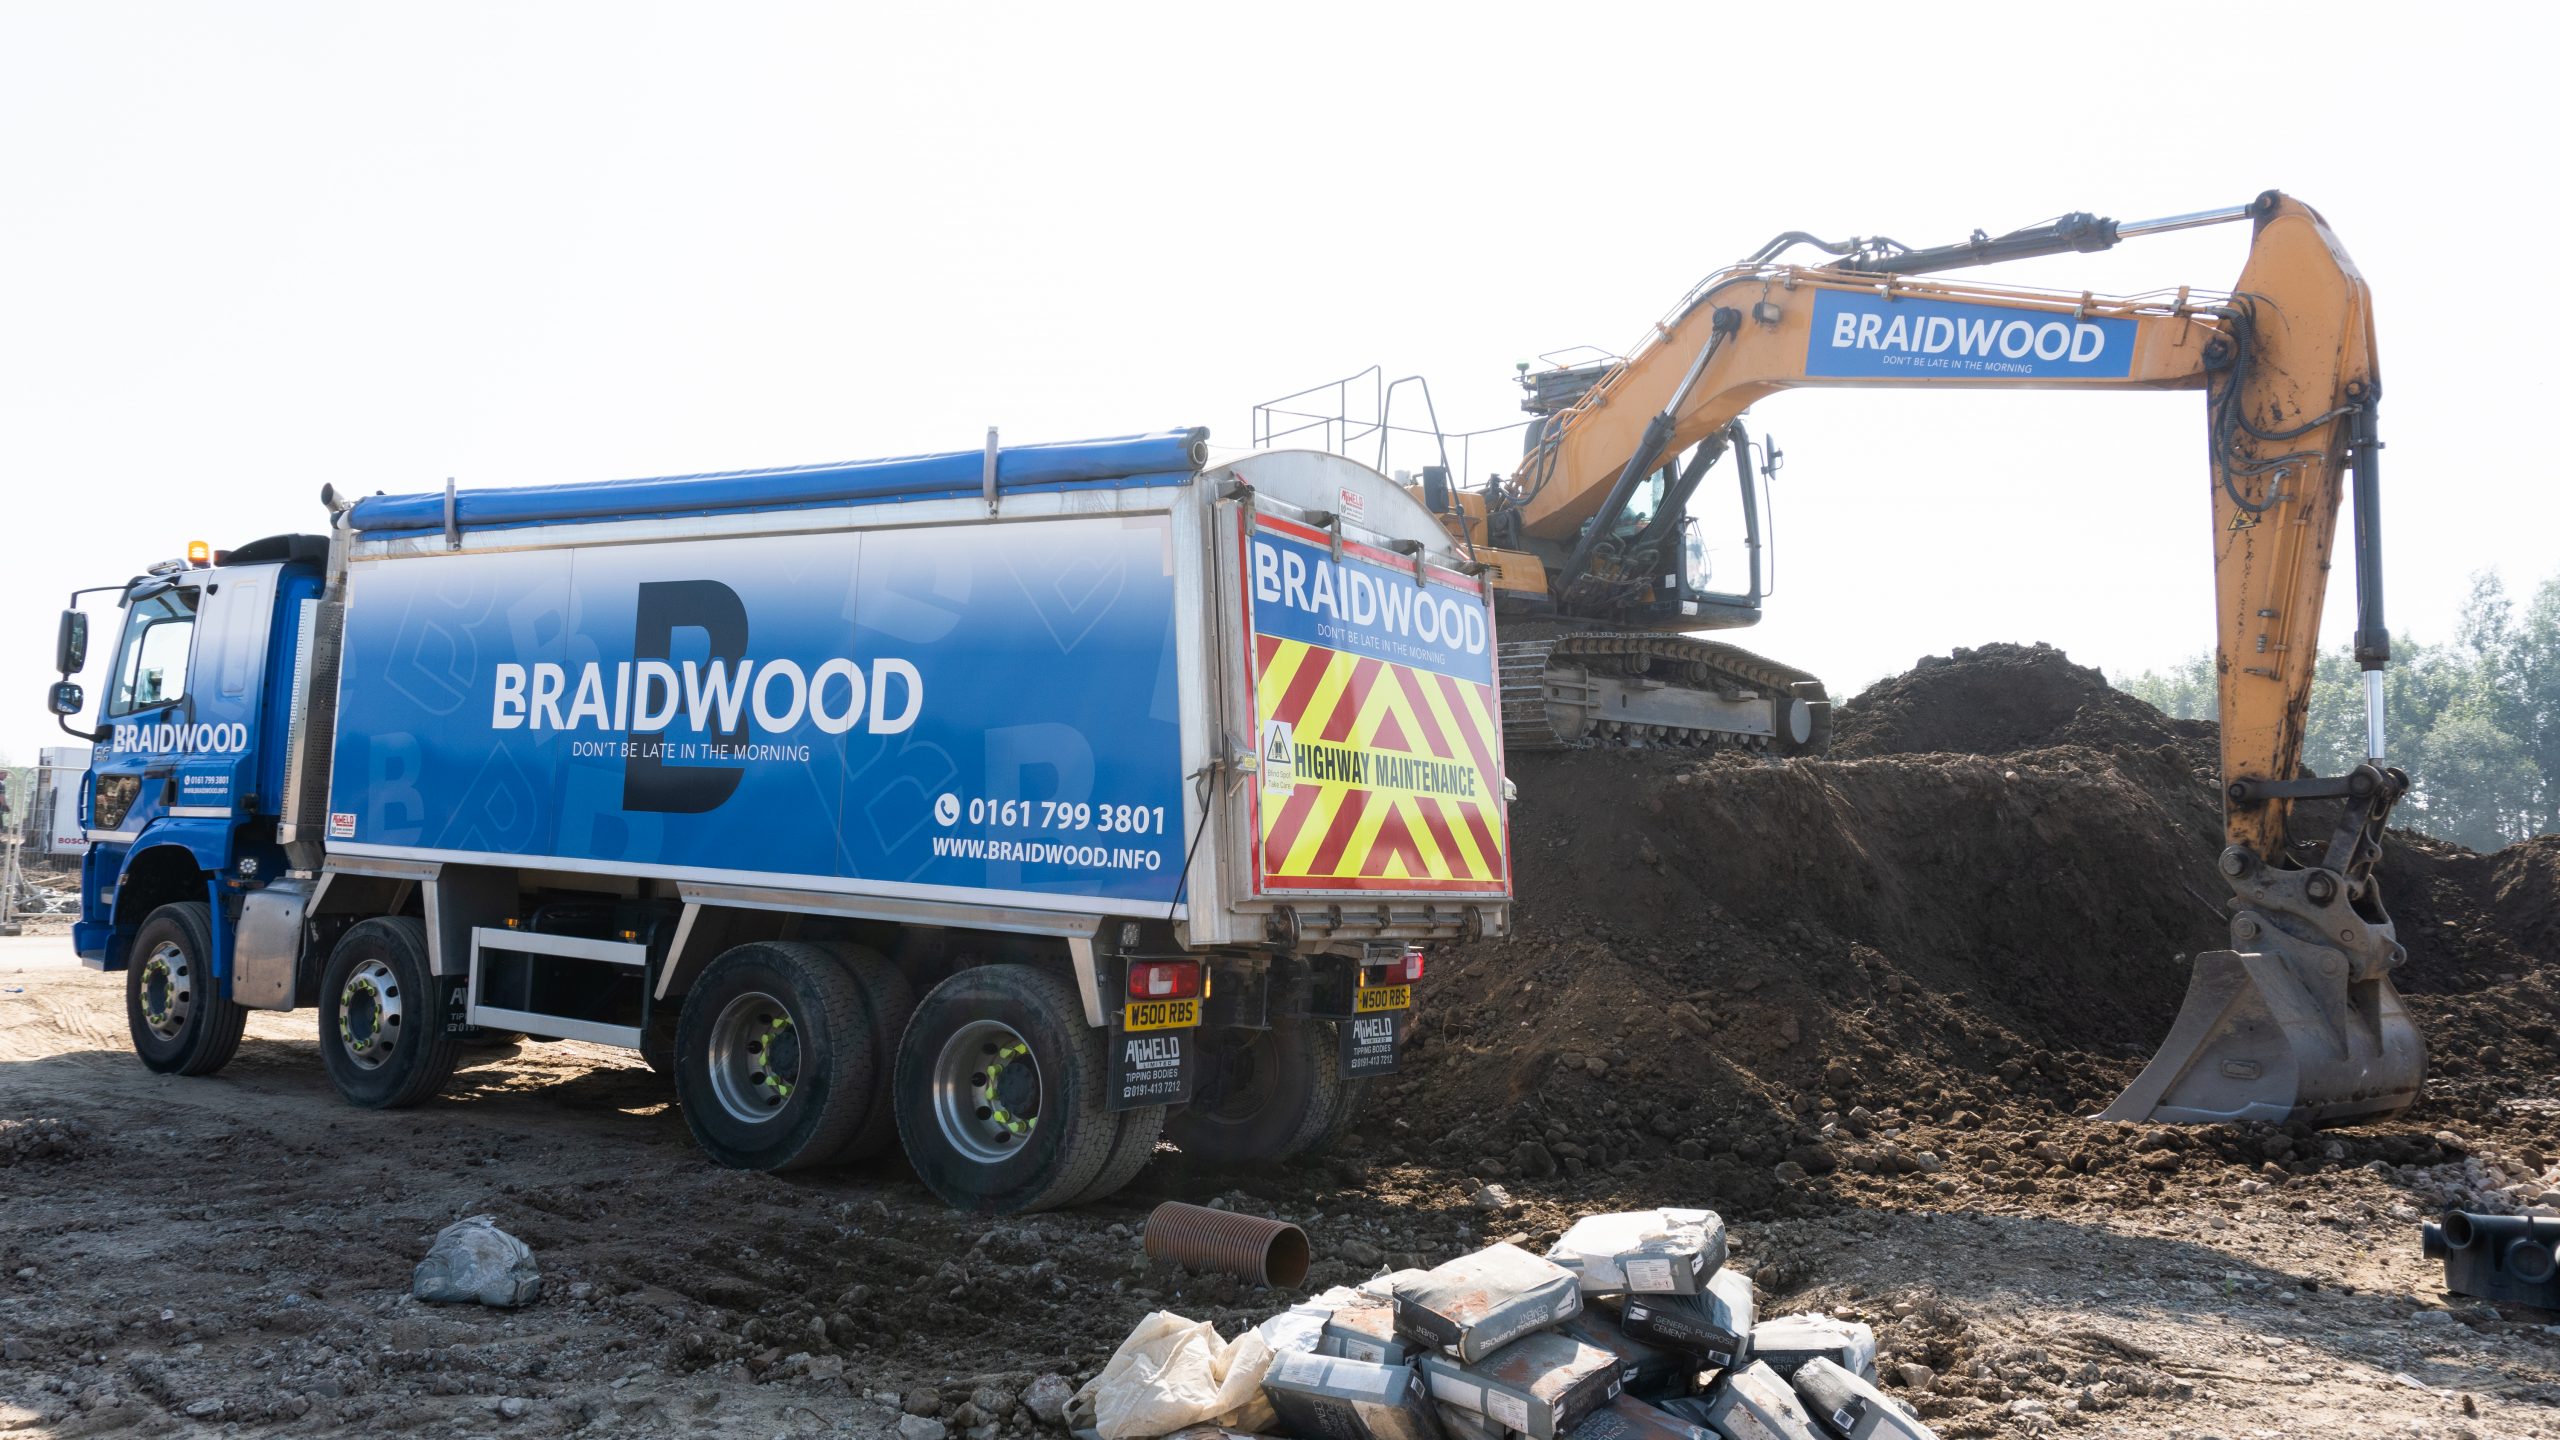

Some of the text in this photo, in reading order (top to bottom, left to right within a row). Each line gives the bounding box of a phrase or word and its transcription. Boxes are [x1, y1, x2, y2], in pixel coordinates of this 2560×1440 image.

[1832, 312, 2105, 363] BRAIDWOOD
[1883, 355, 2033, 374] DON'T BE LATE IN THE MORNING
[1254, 541, 1486, 655] BRAIDWOOD
[1317, 623, 1446, 665] DON'T BE LATE IN THE MORNING
[492, 657, 924, 734] BRAIDWOOD
[113, 723, 248, 753] BRAIDWOOD
[572, 741, 810, 762] DON'T BE LATE IN THE MORNING
[1294, 743, 1476, 797] HIGHWAY MAINTENANCE
[969, 798, 1165, 835] 0161 799 3801
[933, 837, 1161, 871] WWW.BRAIDWOOD.INFO
[1362, 988, 1406, 1008] W500 RBS
[1132, 1002, 1194, 1026] W500 RBS
[1354, 1044, 1391, 1055] TIPPING BODIES
[1380, 1054, 1393, 1064] 7212
[1126, 1068, 1178, 1083] TIPPING BODIES
[1131, 1080, 1181, 1097] 0191-413 7212
[1480, 1327, 1516, 1350] PURPOSE
[1652, 1324, 1687, 1340] CEMENT
[1655, 1315, 1736, 1346] GENERAL PURPOSE
